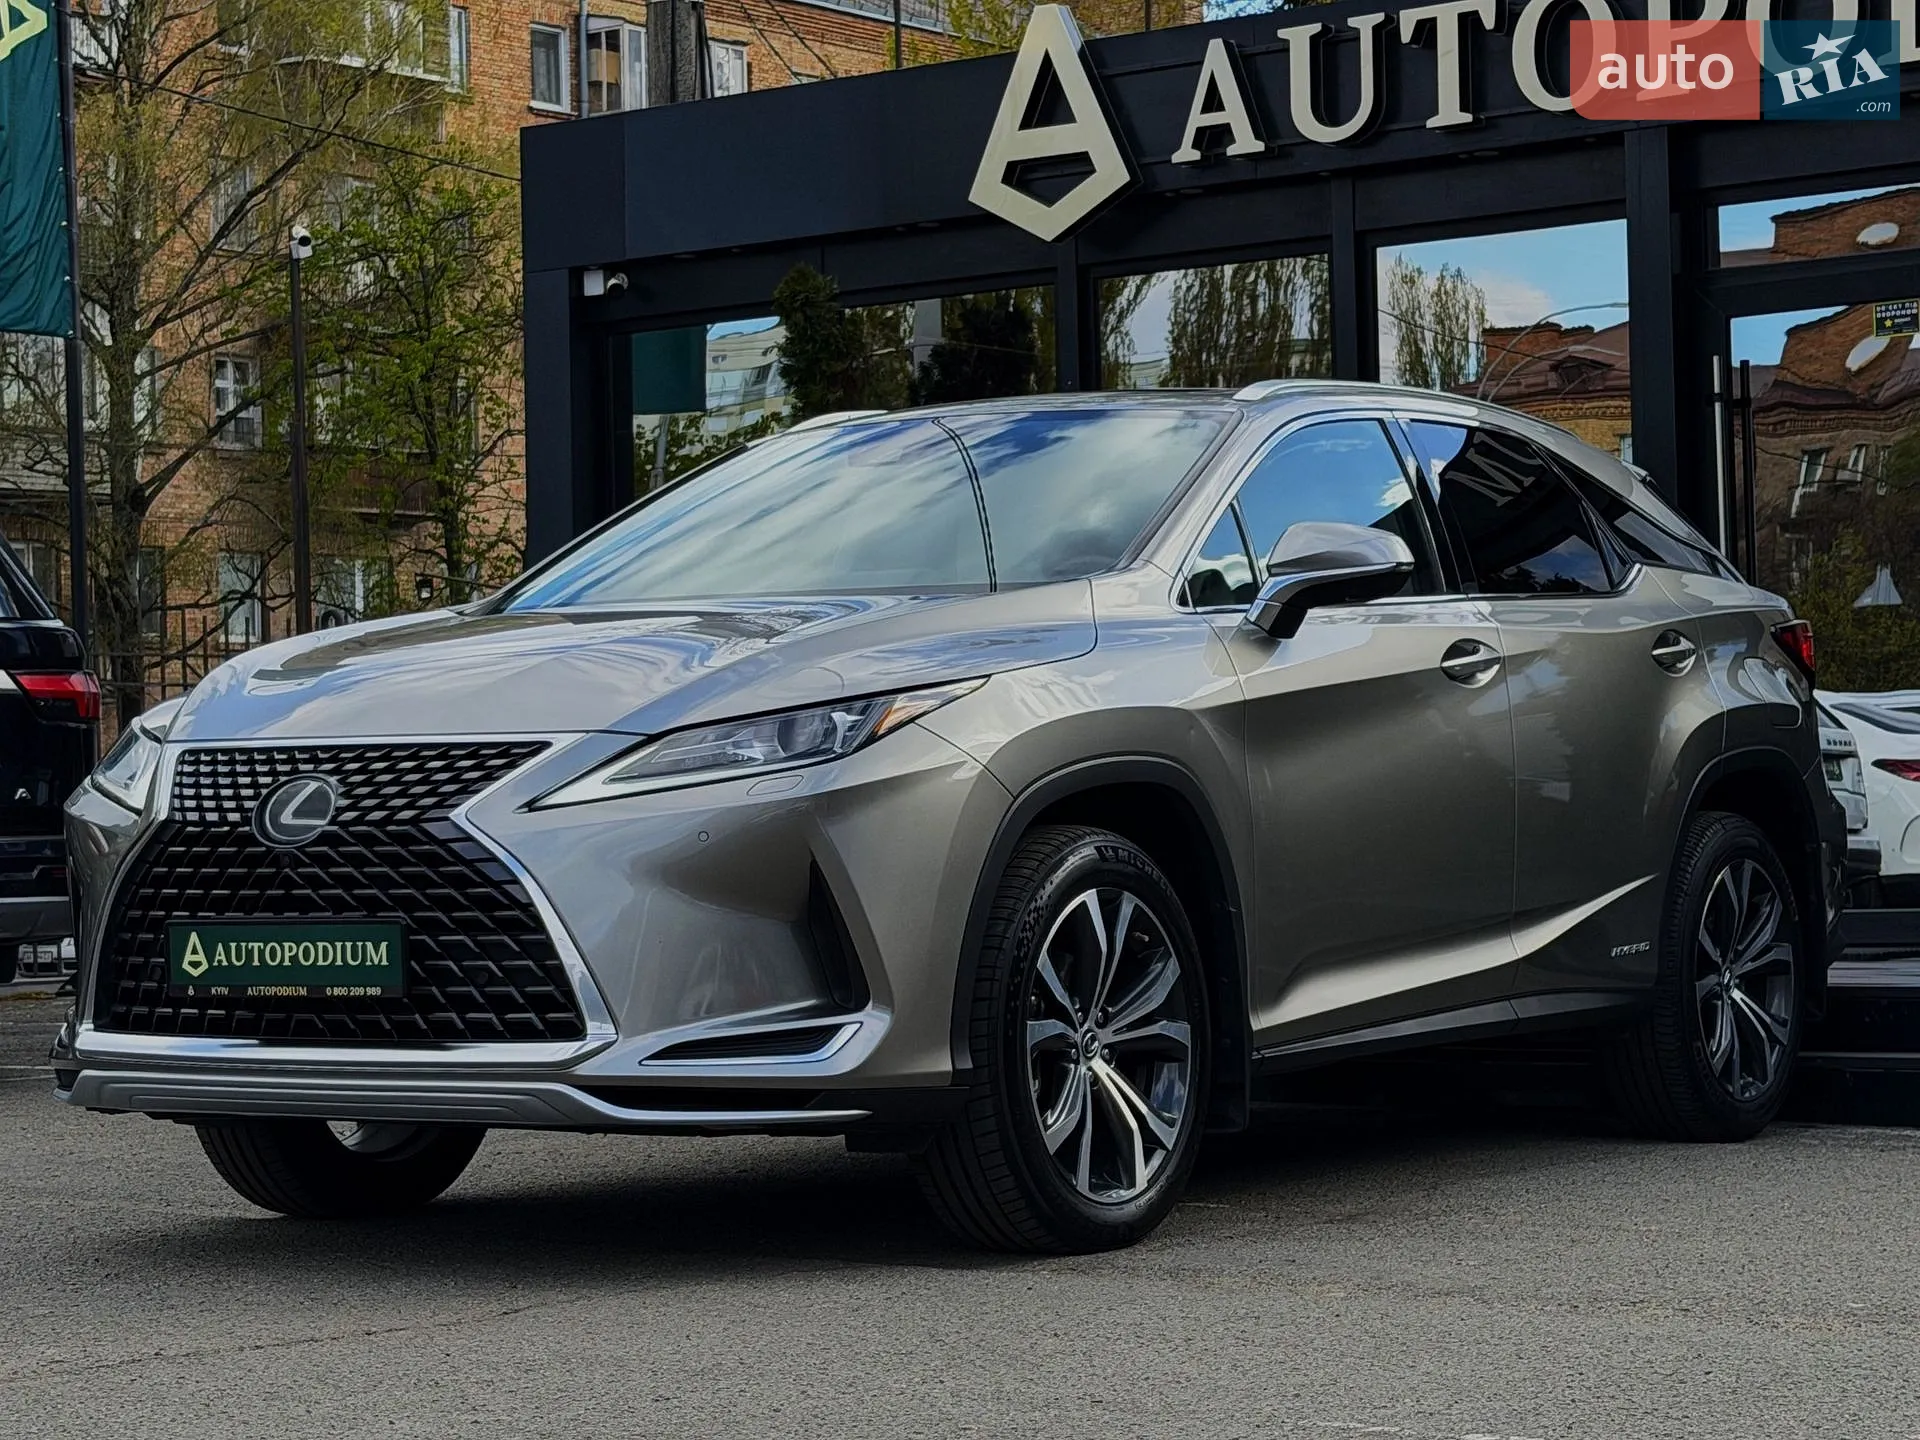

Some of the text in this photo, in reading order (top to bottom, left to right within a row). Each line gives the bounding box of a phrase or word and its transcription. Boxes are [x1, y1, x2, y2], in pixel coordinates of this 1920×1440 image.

[213, 941, 389, 966] AUTOPODIUM
[211, 986, 382, 996] KYIV AUTOPODIUM 0 800 209 989
